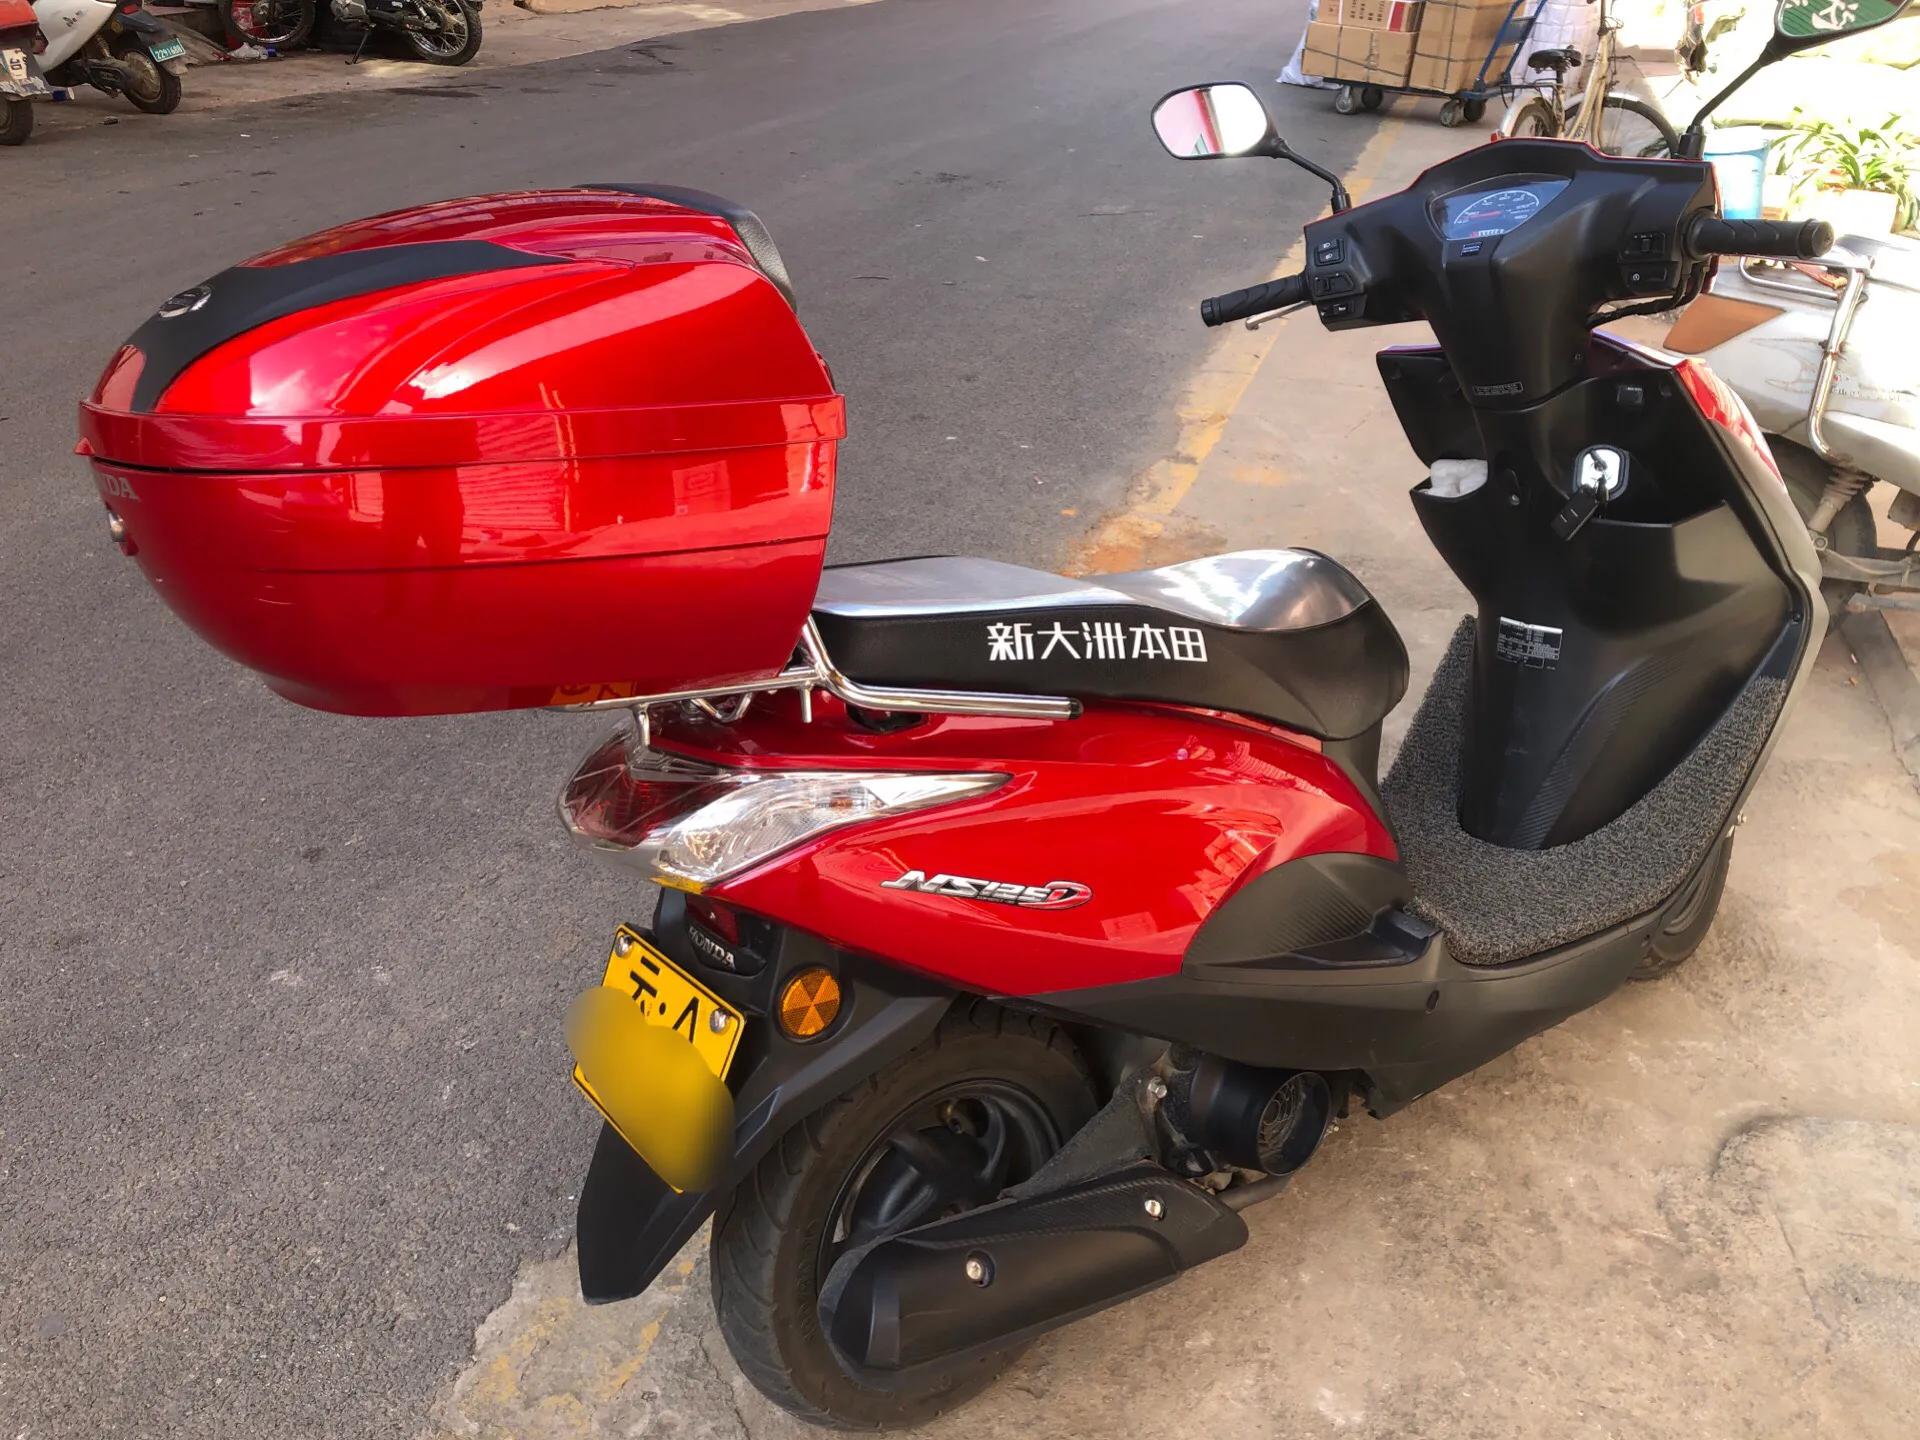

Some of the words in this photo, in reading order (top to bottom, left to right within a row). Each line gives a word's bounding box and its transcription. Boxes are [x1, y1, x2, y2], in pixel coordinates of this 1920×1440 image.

[986, 621, 1208, 663] 新大洲本田
[688, 926, 736, 971] HONDA
